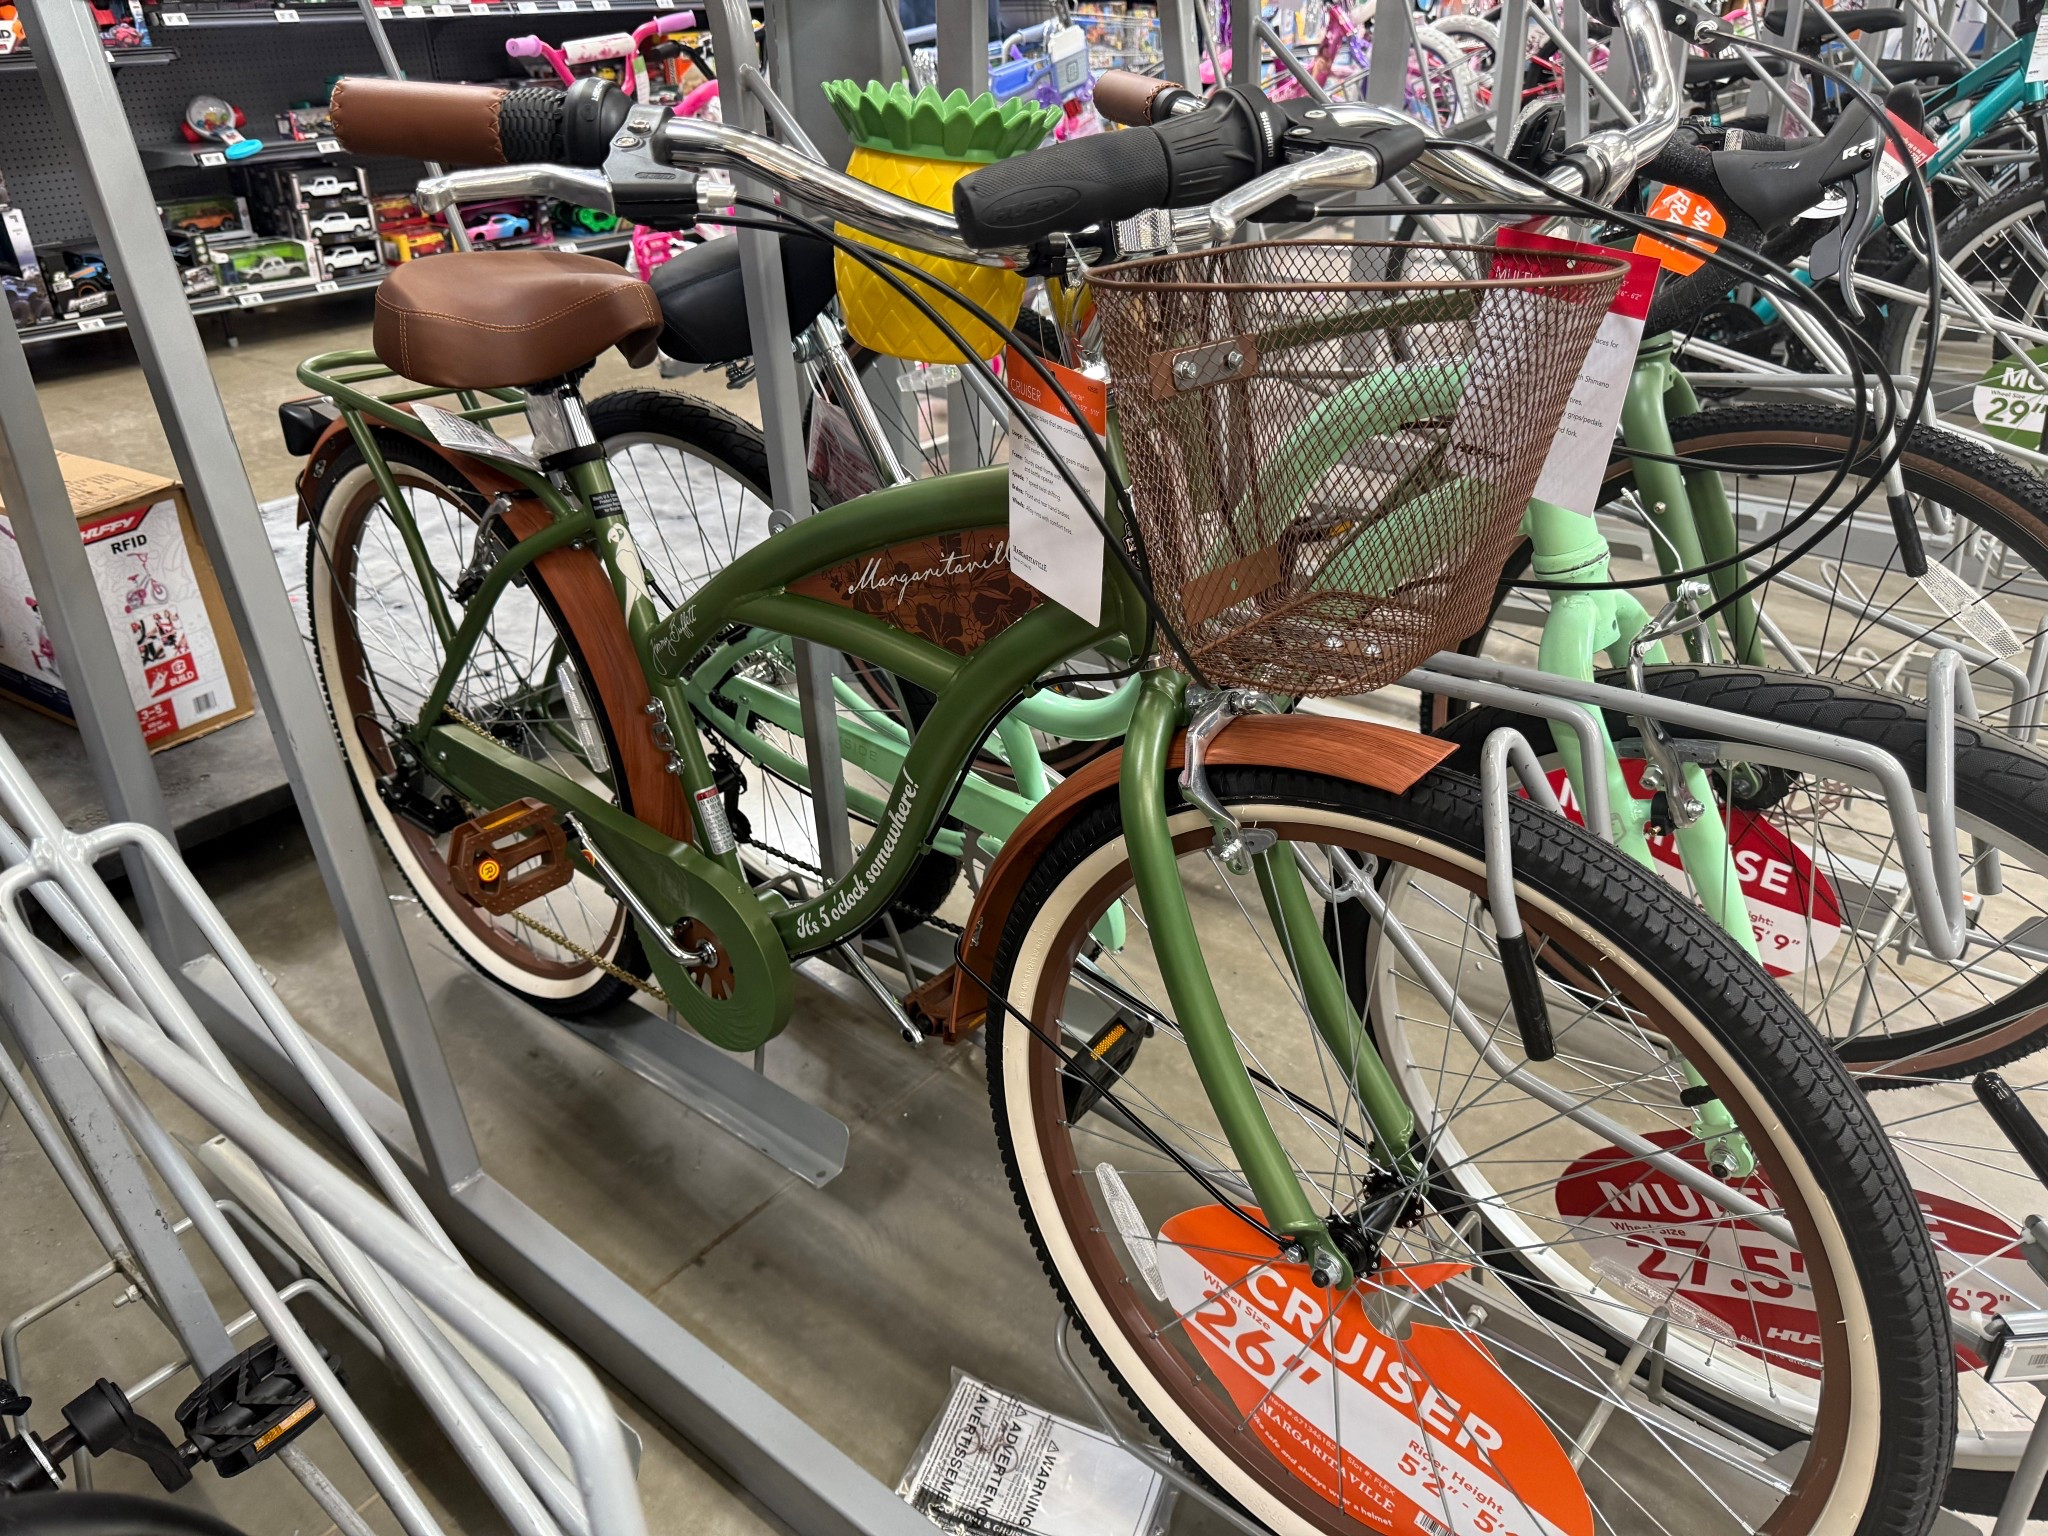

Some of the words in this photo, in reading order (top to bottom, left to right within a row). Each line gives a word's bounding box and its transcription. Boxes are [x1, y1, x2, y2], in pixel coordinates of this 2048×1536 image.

[1259, 111, 1274, 158] SHIMANO
[1010, 378, 1042, 403] CRUISER
[80, 516, 136, 540] HUFFY
[110, 534, 148, 555] RFID
[848, 541, 1011, 606] Margaritavill
[169, 670, 195, 687] BUILD
[843, 736, 878, 762] SIDE
[796, 911, 821, 939] It's
[818, 904, 831, 928] 5
[830, 873, 870, 921] o'clock
[865, 765, 920, 884] somewhere!
[1735, 849, 1795, 896] SE
[1747, 910, 1774, 927] ight:
[1203, 1270, 1242, 1309] Wheel
[1244, 1306, 1271, 1332] Size
[1194, 1289, 1322, 1386] 26"
[1246, 1264, 1503, 1468] CRUISER
[1259, 1401, 1396, 1514] MARGARITAVILLE
[1268, 1395, 1286, 1412] Item
[1346, 1456, 1363, 1472] Slot
[1373, 1477, 1396, 1497] FLEX
[1397, 1452, 1459, 1499] 5'2"
[1408, 1439, 1449, 1473] Rider
[1451, 1471, 1504, 1515] Height
[1019, 1454, 1057, 1528] WARNING
[1281, 1449, 1298, 1466] and
[1297, 1465, 1327, 1490] always
[1360, 1506, 1394, 1528] helmet
